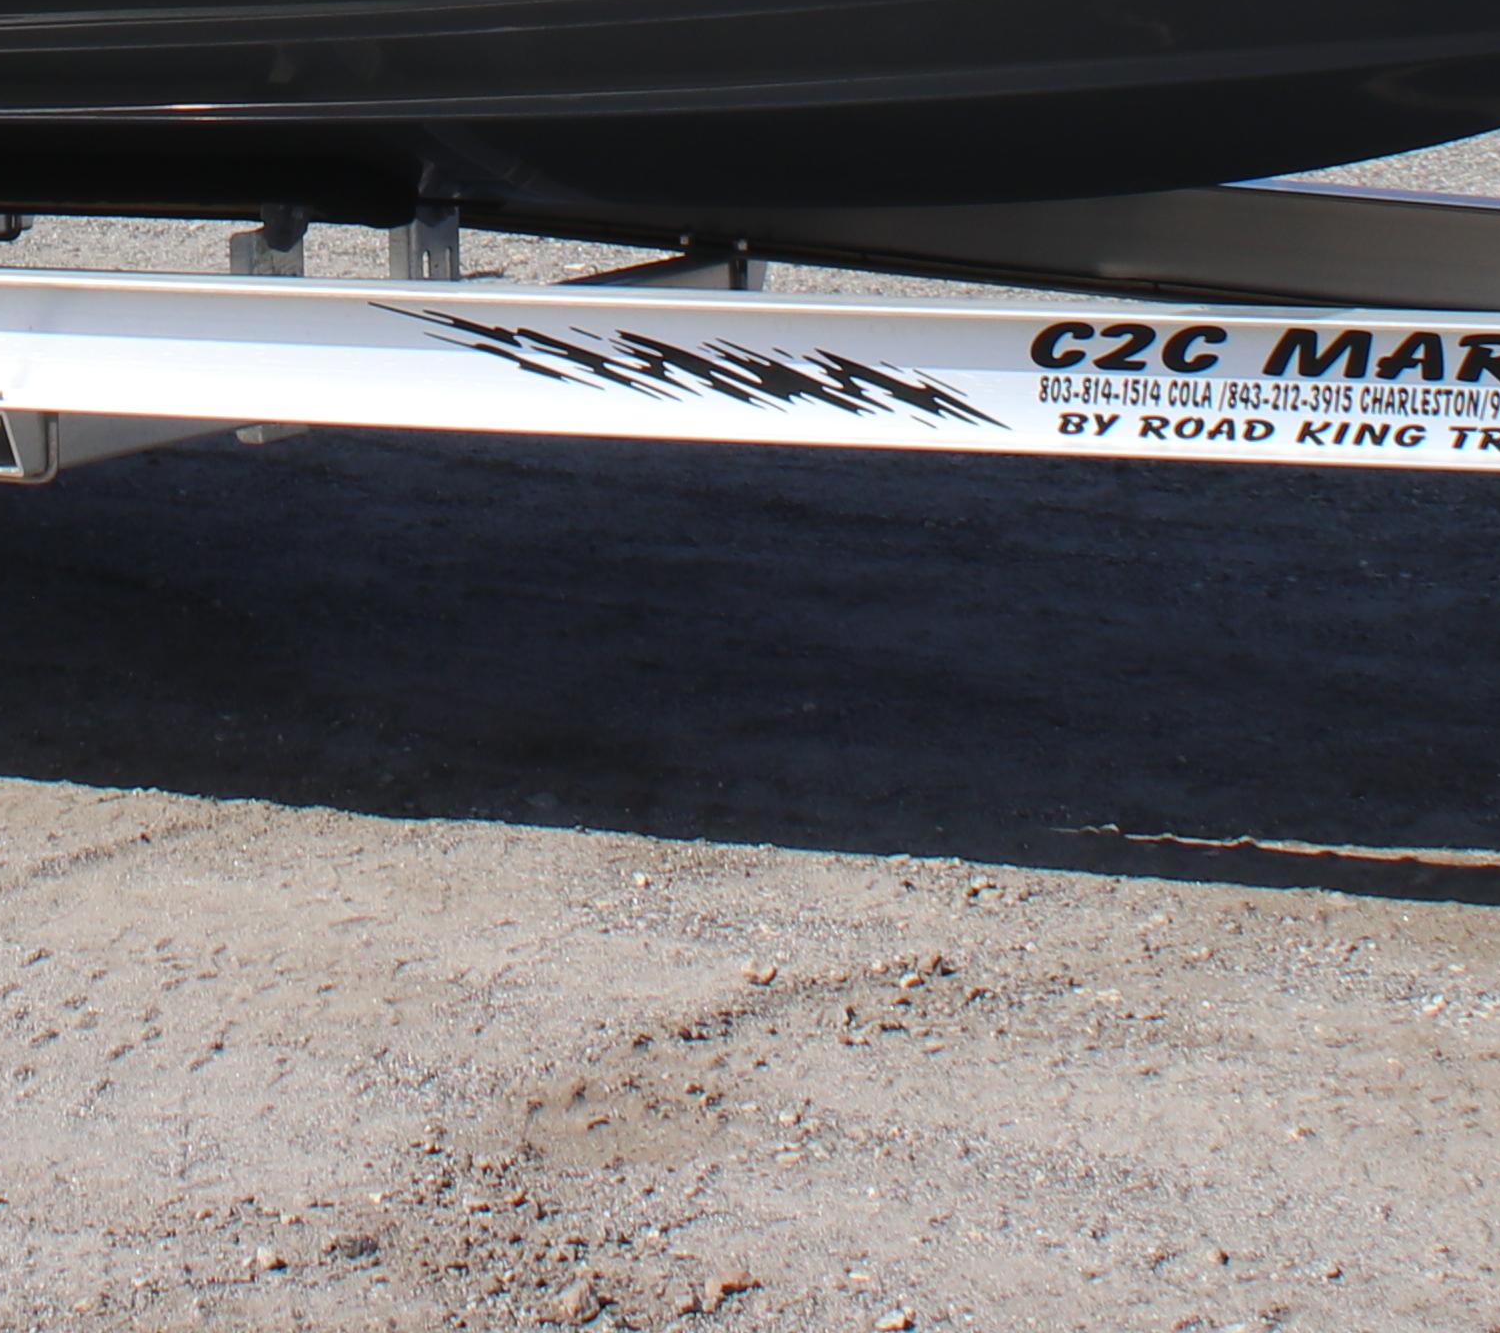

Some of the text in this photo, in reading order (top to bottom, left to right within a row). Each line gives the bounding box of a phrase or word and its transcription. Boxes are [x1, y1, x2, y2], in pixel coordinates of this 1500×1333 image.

[1030, 321, 1228, 374] C2C
[1039, 375, 1161, 406] 803-814-1514
[1167, 379, 1213, 410] COLA
[1218, 380, 1354, 414] /843-212-3915
[1058, 411, 1121, 437] BY
[1138, 414, 1276, 443] ROAD
[1295, 419, 1427, 448] KING
